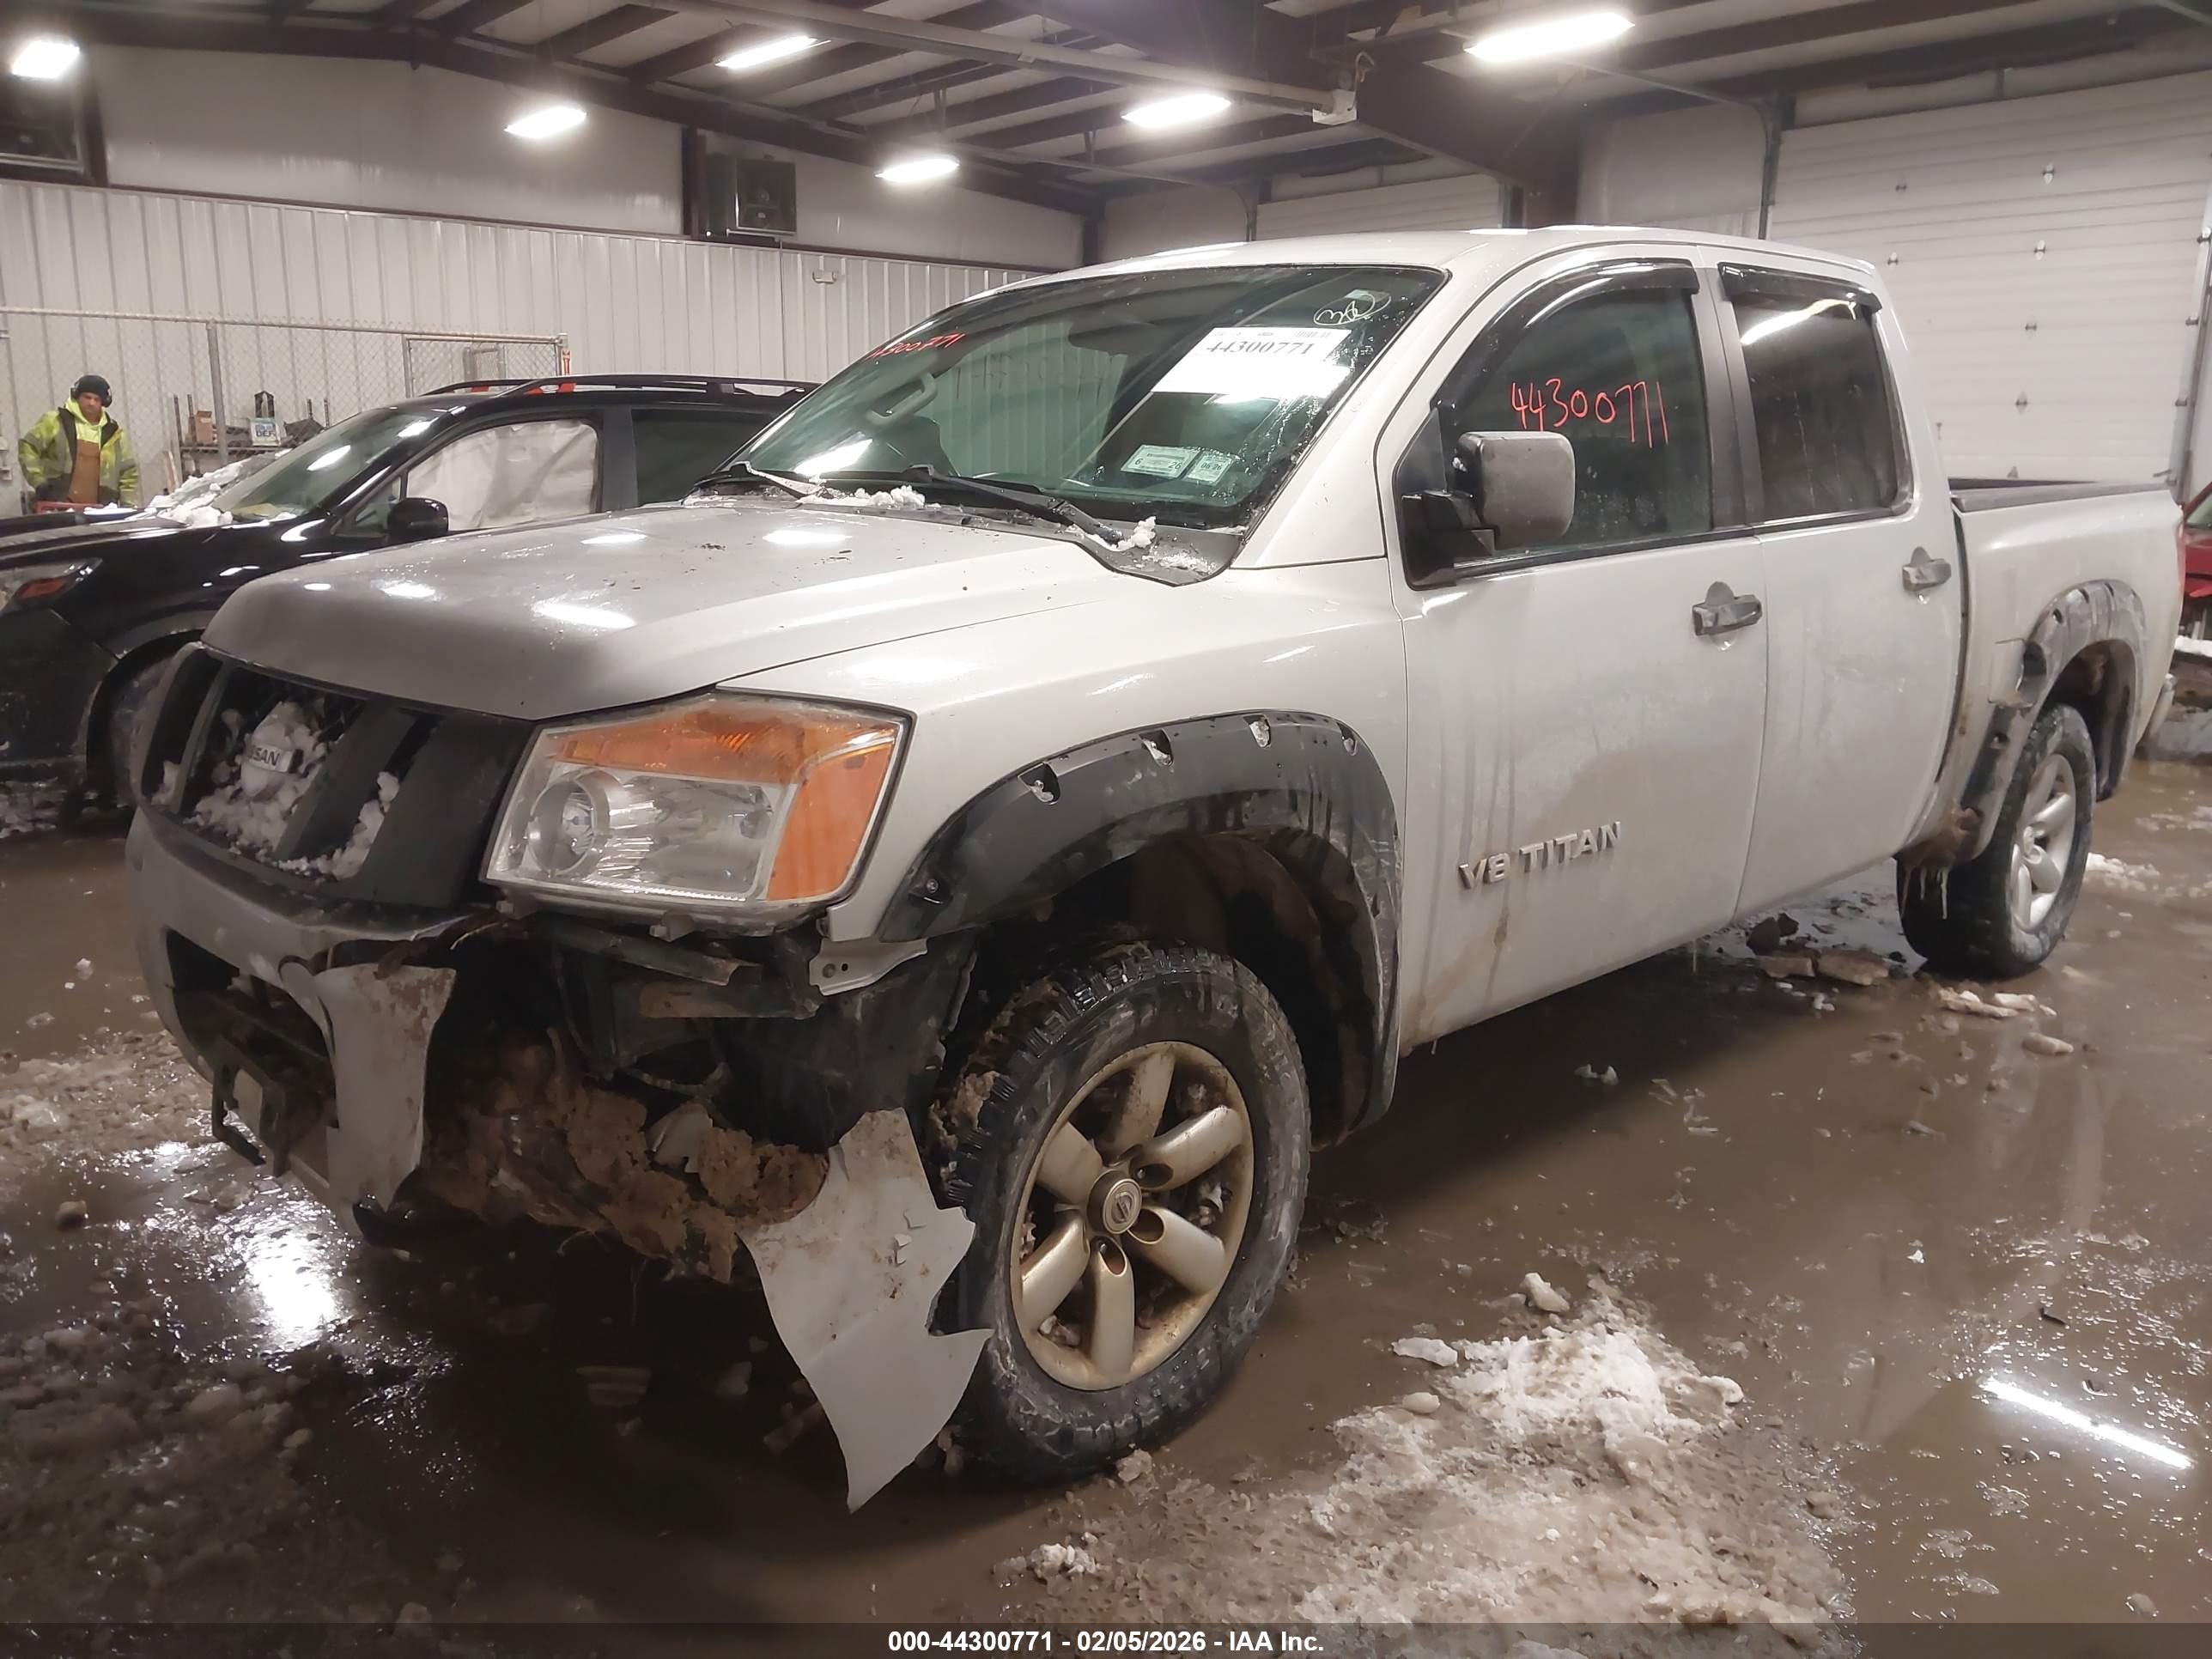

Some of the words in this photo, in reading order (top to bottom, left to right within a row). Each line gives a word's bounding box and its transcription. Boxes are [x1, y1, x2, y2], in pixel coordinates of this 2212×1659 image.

[1206, 341, 1316, 356] 44300771
[1510, 377, 1669, 449] 44300771
[1459, 853, 1510, 890] V8
[1519, 821, 1622, 873] TITAN
